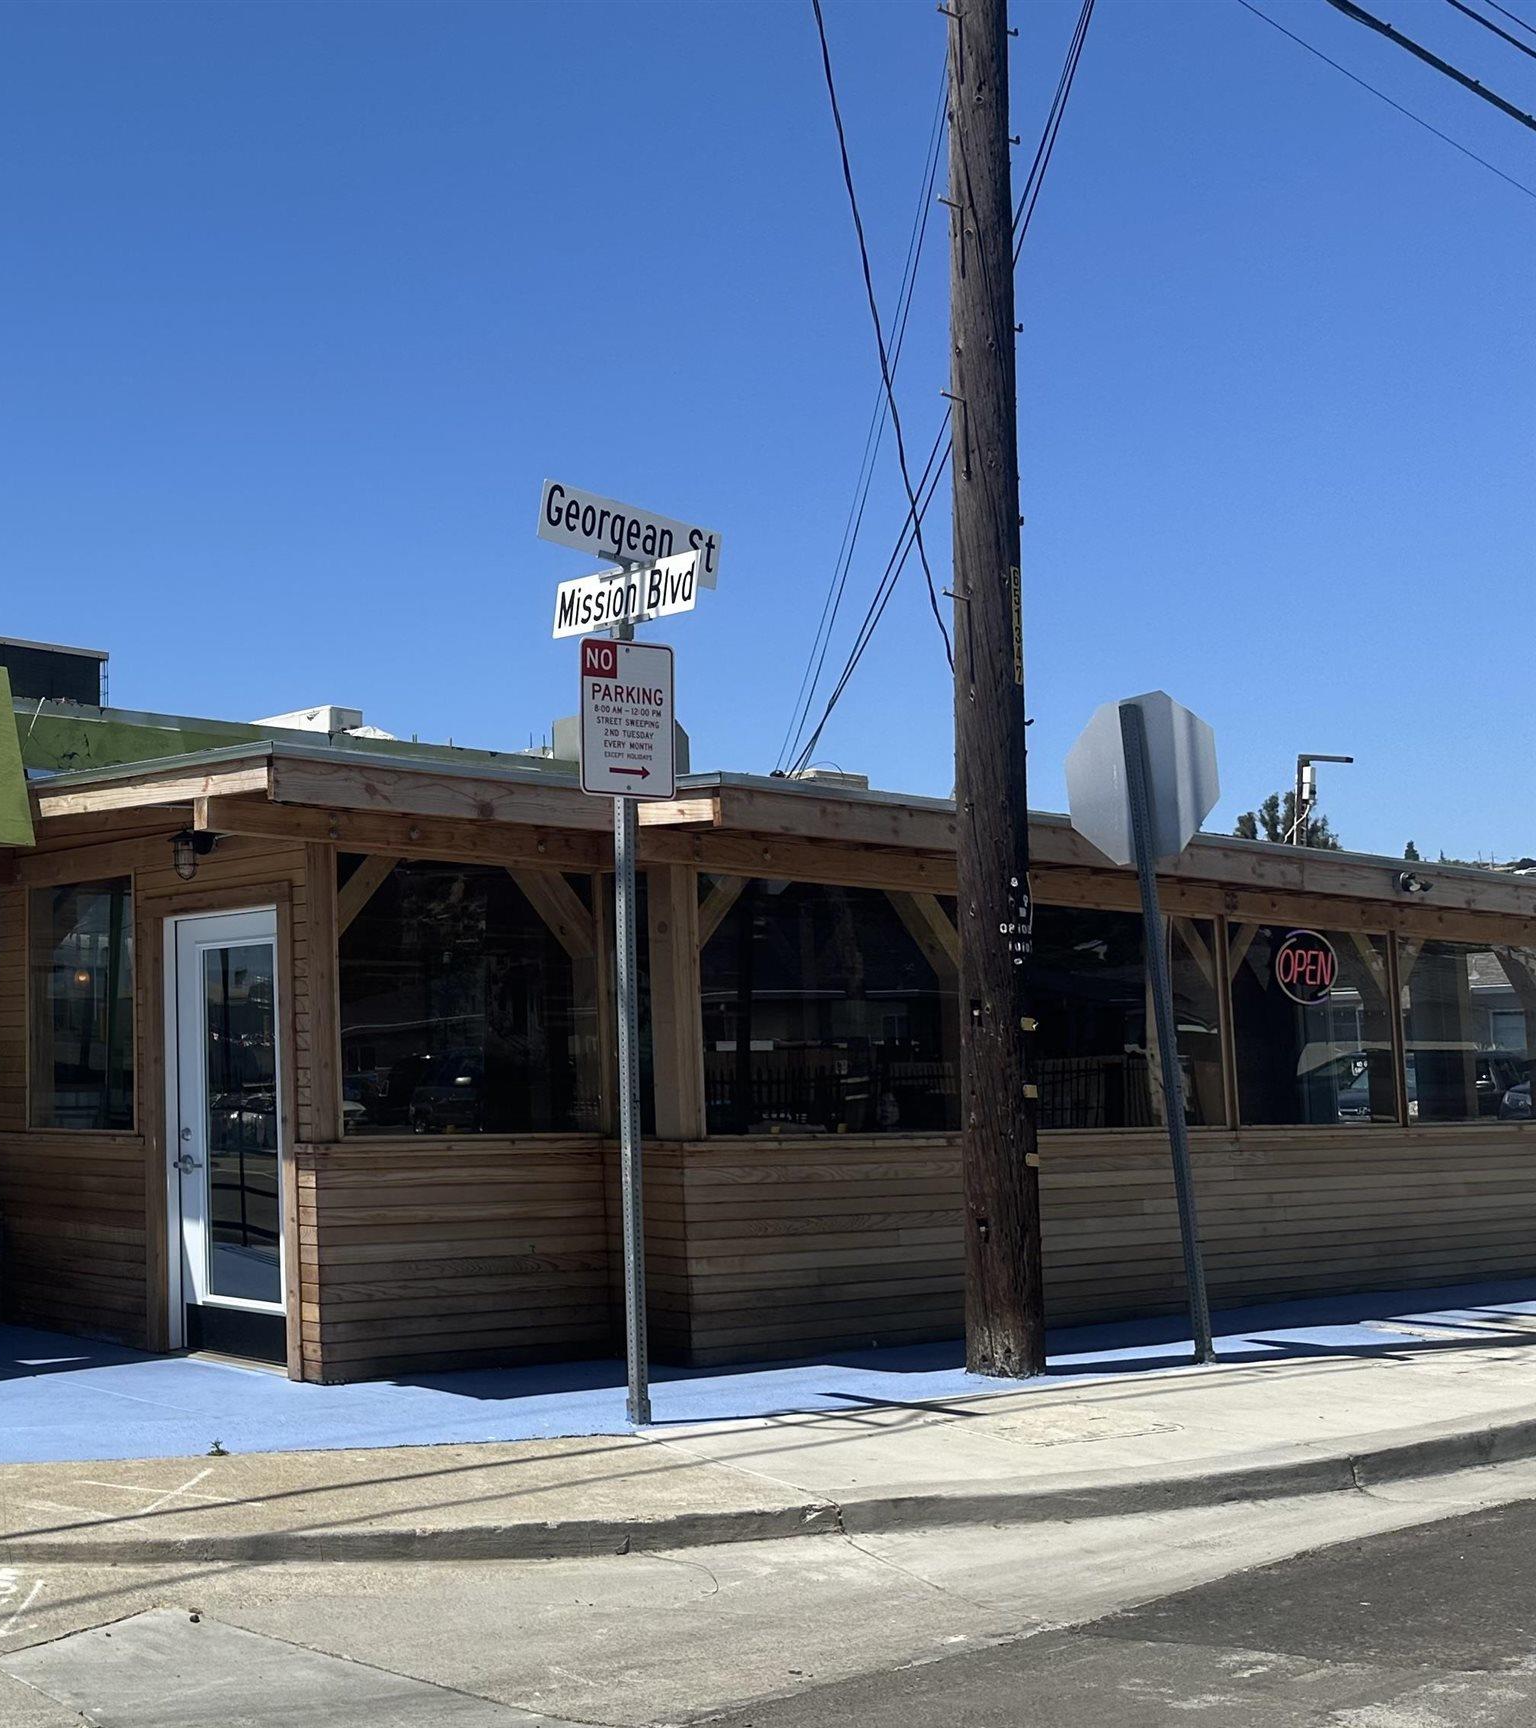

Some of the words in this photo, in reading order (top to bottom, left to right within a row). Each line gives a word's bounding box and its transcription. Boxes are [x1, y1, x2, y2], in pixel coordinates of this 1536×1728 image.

[546, 484, 674, 556] Georgean
[558, 580, 637, 629] Mission
[647, 560, 695, 610] Blvd
[586, 647, 613, 671] NO
[592, 682, 663, 706] PARKING
[596, 716, 622, 725] STREET
[625, 718, 660, 729] SWEEPING
[612, 705, 622, 714] AM
[652, 709, 662, 717] PM
[604, 728, 619, 737] 2ND
[622, 730, 654, 740] TUESDAY
[604, 740, 625, 749] EVERY
[629, 741, 653, 751] MONTH
[1280, 948, 1332, 985] OPEN
